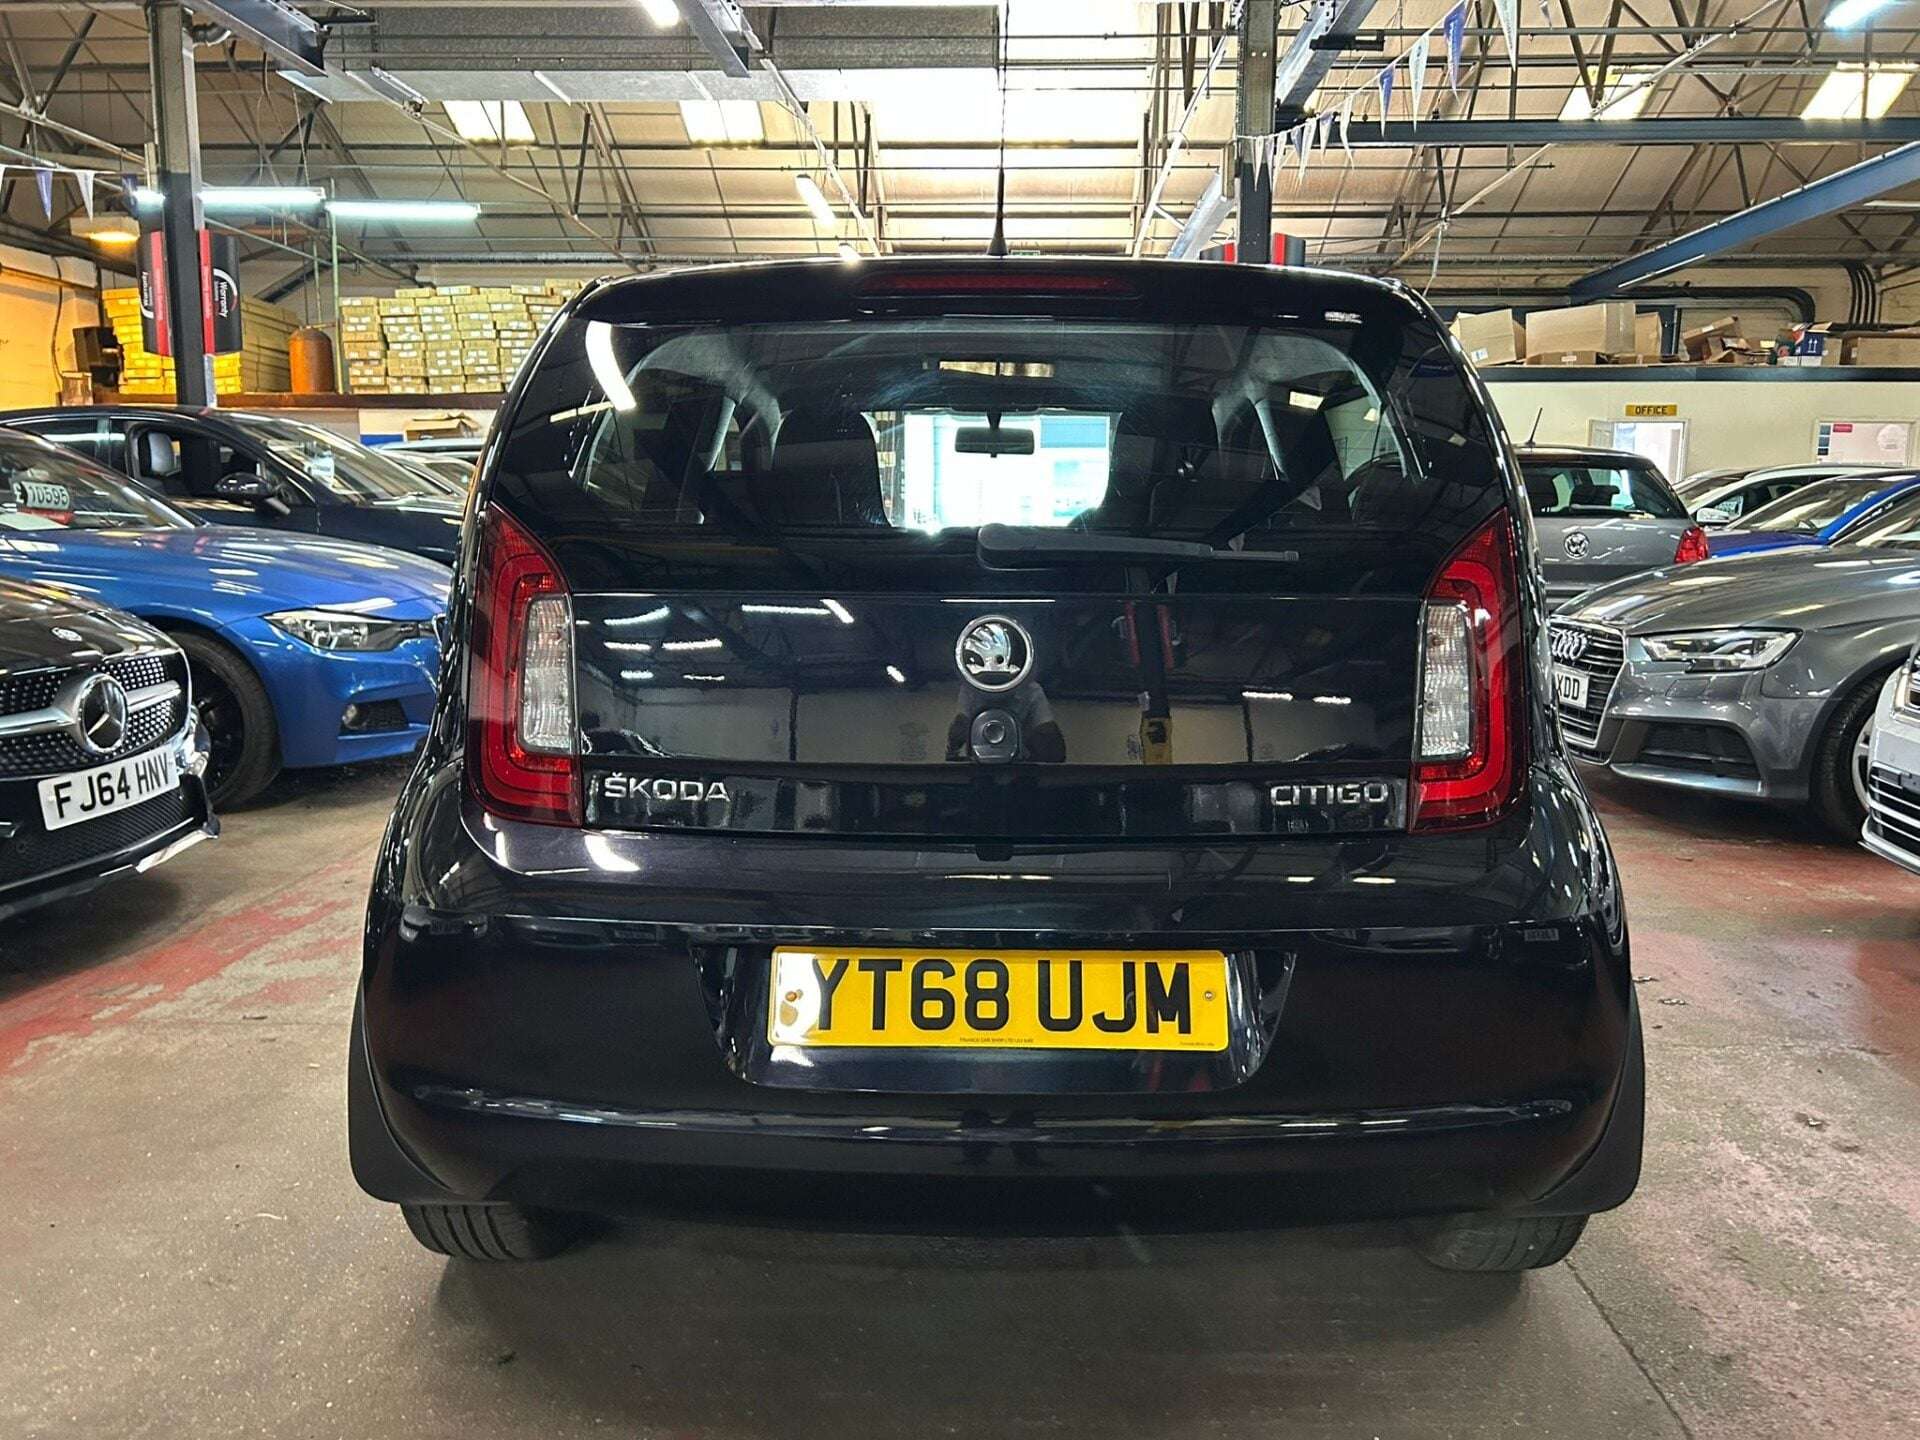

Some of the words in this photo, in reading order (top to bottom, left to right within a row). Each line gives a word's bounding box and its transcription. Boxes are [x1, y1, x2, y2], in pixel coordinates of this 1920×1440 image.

[1635, 405, 1668, 415] OFFICE
[54, 767, 131, 819] FJ64
[135, 752, 169, 795] HNV
[604, 772, 731, 802] ŠKODA
[1270, 782, 1389, 806] CITIGO
[811, 959, 1010, 1032] YT68
[1037, 960, 1192, 1035] UJM
